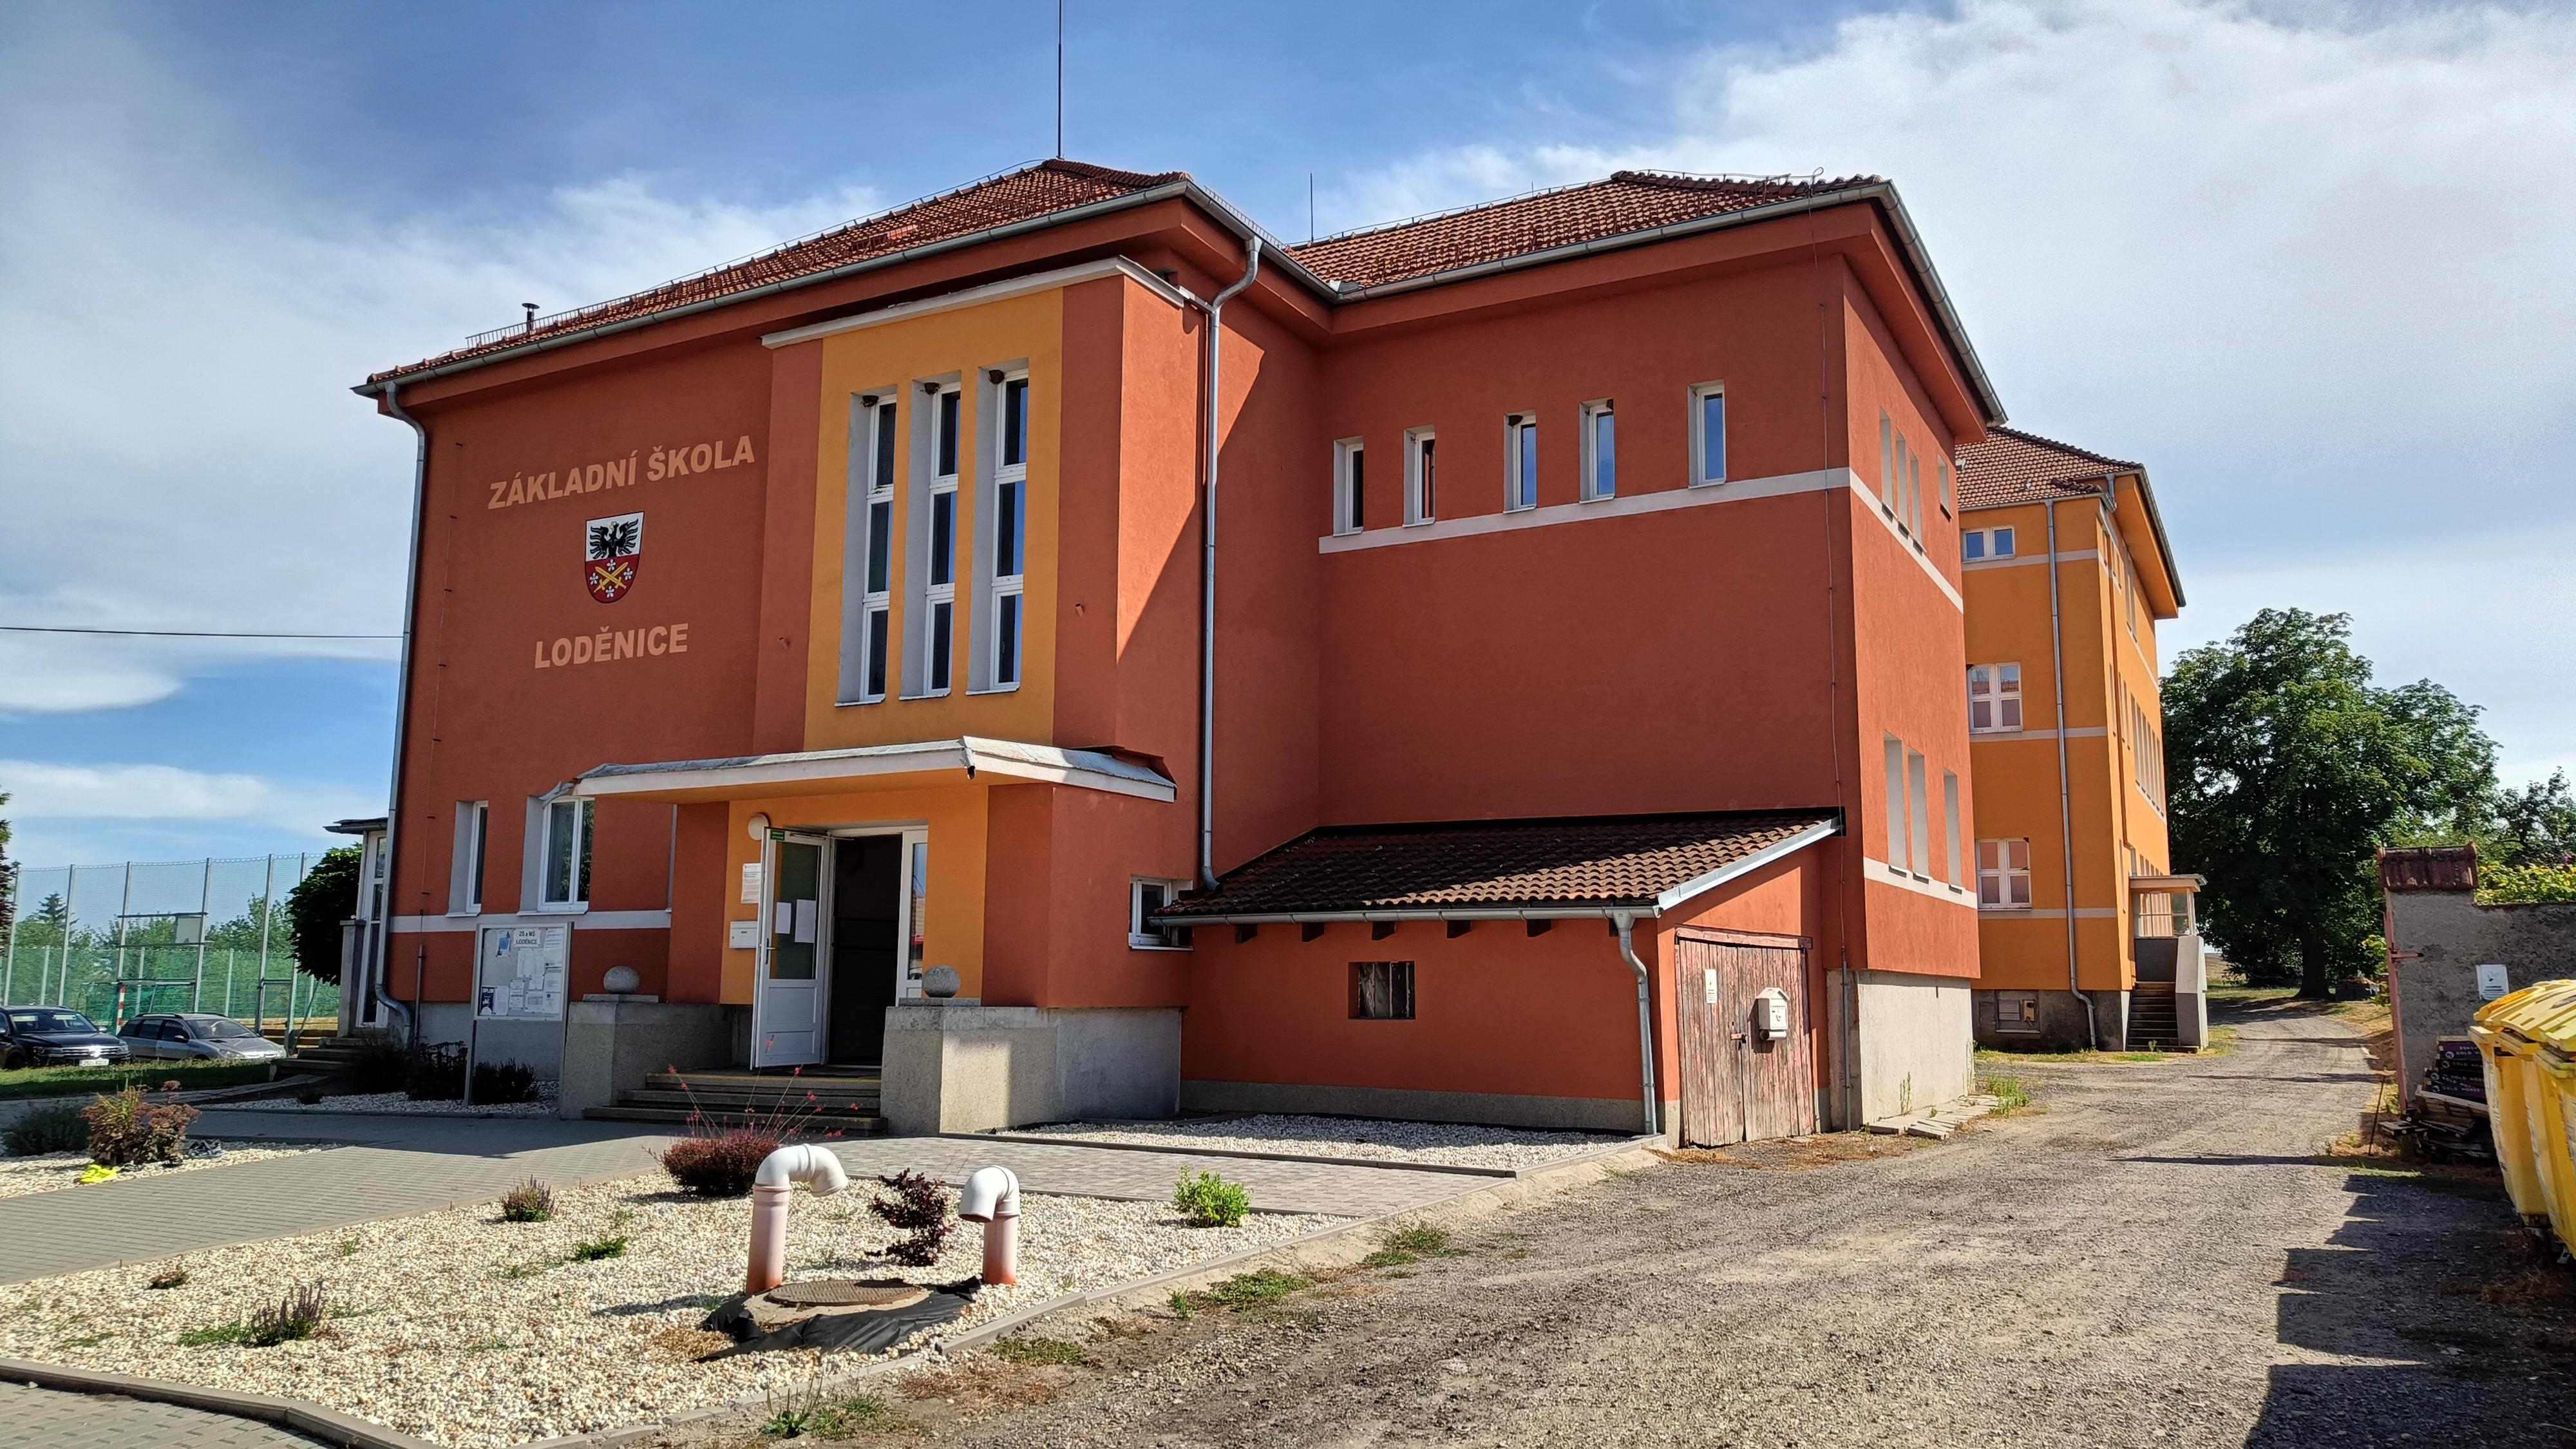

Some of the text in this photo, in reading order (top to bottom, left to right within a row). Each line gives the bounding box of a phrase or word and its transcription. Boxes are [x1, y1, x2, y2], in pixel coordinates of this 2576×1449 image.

[488, 435, 755, 509] ZÁKLADNÍ ŠKOLA
[535, 623, 689, 668] LODĚNICE
